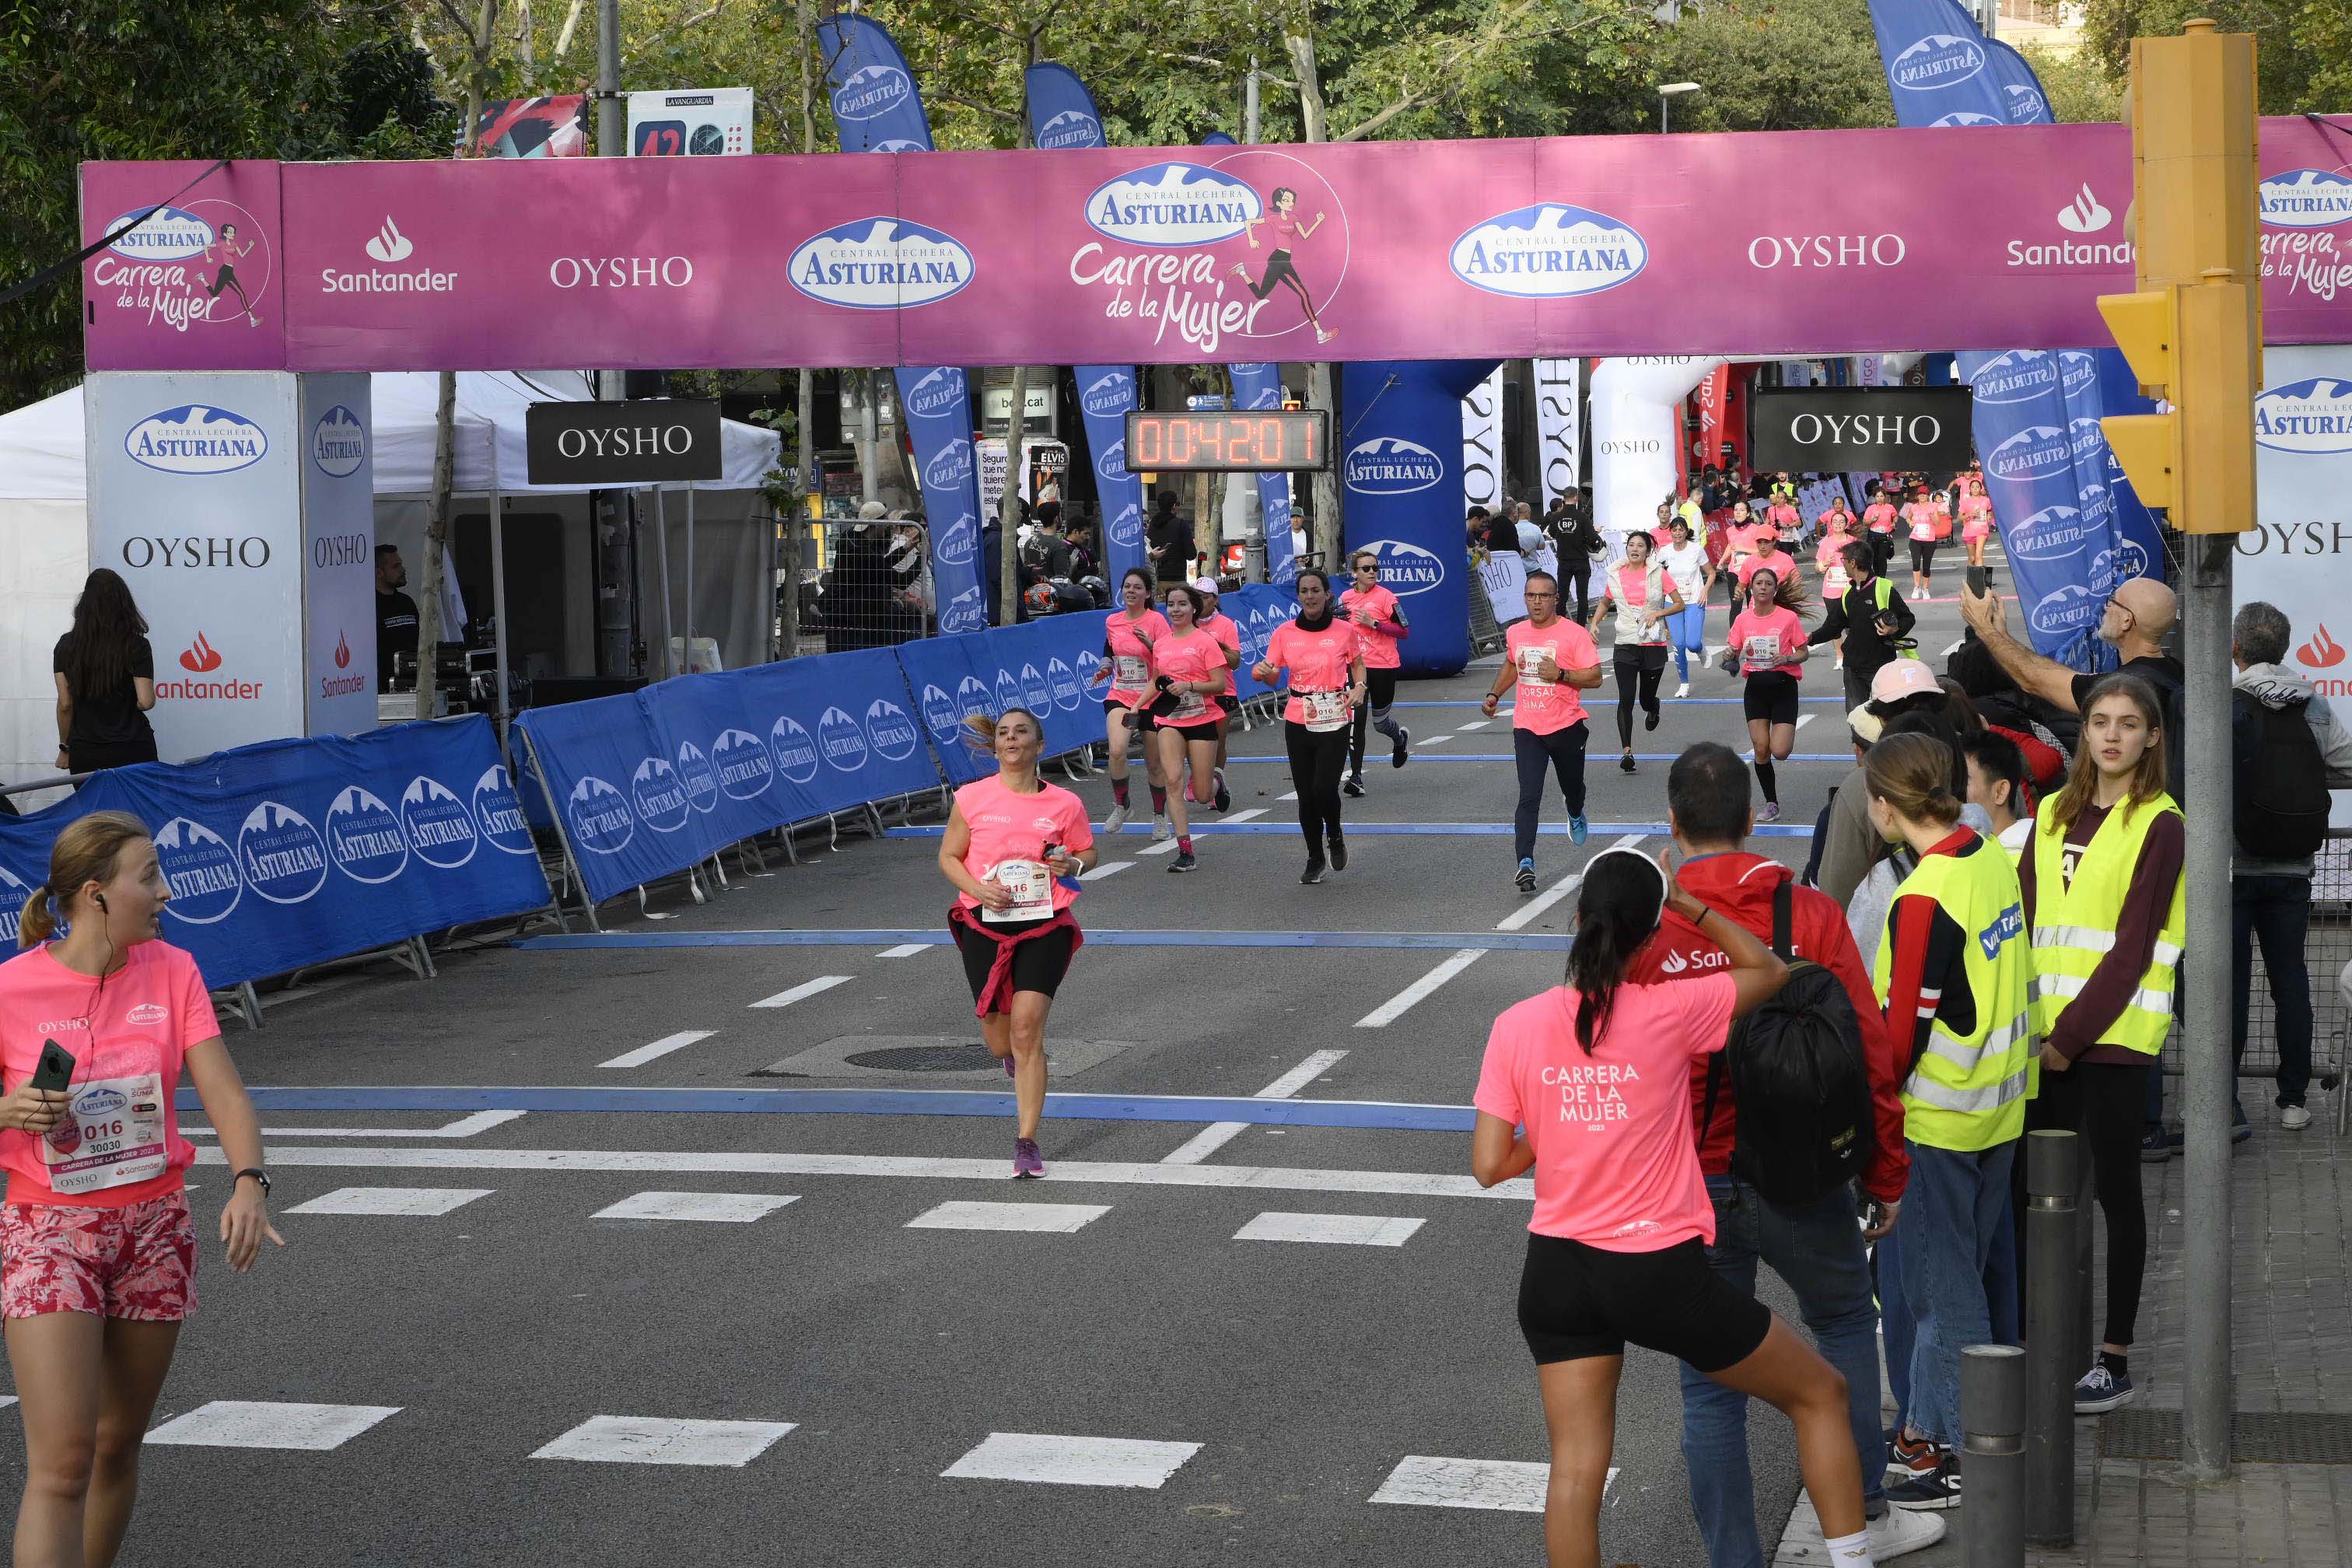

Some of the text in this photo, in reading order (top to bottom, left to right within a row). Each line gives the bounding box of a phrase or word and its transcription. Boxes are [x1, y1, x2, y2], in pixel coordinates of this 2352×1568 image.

[674, 97, 712, 106] VANGUARDIA
[1125, 190, 1243, 201] CENTRAL LECHERA
[1099, 194, 1247, 226] ASTURIANA
[114, 226, 206, 247] ASTURIANA
[1496, 235, 1626, 247] CENTRAL LECHERA
[2259, 233, 2335, 254] arrera
[831, 247, 954, 257] CENTRAL LECHERA
[1465, 240, 1632, 274] ASTURIANA
[1748, 233, 1906, 268] OYSHO
[2007, 240, 2136, 265] Santand
[94, 257, 187, 286] Carrera
[550, 257, 693, 288] OYSHO
[802, 252, 960, 285] ASTURIANA
[1070, 243, 1215, 285] Carrera
[2279, 255, 2292, 276] la
[2289, 250, 2352, 301] Muje
[322, 268, 458, 293] Santander
[117, 283, 220, 332] de la Mujer
[1106, 278, 1270, 353] de la Mujer
[1002, 397, 1043, 408] b.cat
[1790, 414, 1941, 446] OYSHO
[2256, 407, 2352, 435] ASTURI
[136, 431, 257, 457] ASTURIANA
[317, 432, 362, 460] ASTURIANA
[558, 425, 692, 458] OYSHO
[1138, 419, 1313, 463] 00:42:01
[1601, 439, 1660, 454] OYSHO
[1041, 453, 1065, 462] ELVIS
[1347, 460, 1437, 481] ASTURIANA
[2235, 522, 2352, 555] OYSH
[123, 537, 270, 569] OYSHO
[315, 534, 366, 569] OYSHO
[1376, 567, 1437, 582] URIANA
[1482, 559, 1512, 594] SHO
[156, 678, 263, 699] antander
[322, 672, 365, 698] Santander
[776, 744, 815, 769] ASTURIANA
[823, 733, 865, 758] ASTURIANA
[716, 756, 768, 786] ASTURIANA
[341, 820, 366, 831] CENTRAL
[414, 809, 436, 819] CENTRAL
[481, 802, 528, 835] ASTUR
[254, 831, 311, 850] CENTRAL LECHERA
[408, 813, 474, 849] ASTURIANA
[334, 825, 404, 863] ASTURIANA
[166, 855, 196, 867] CENTRAL
[247, 844, 324, 883] ASTURIANA
[0, 892, 26, 905] ECHERA
[39, 1018, 90, 1033] OYSHO
[1541, 1064, 1640, 1086] CARRERA
[80, 1099, 123, 1112] ASTURIANA
[1562, 1084, 1623, 1103] DE LA
[1559, 1102, 1629, 1122] MUJER
[85, 1120, 123, 1141] 016
[89, 1140, 121, 1153] 30030
[61, 1159, 93, 1171] CARRERA
[115, 1151, 138, 1160] MUJER
[125, 1162, 160, 1174] Santander
[61, 1174, 97, 1188] OYSHO
